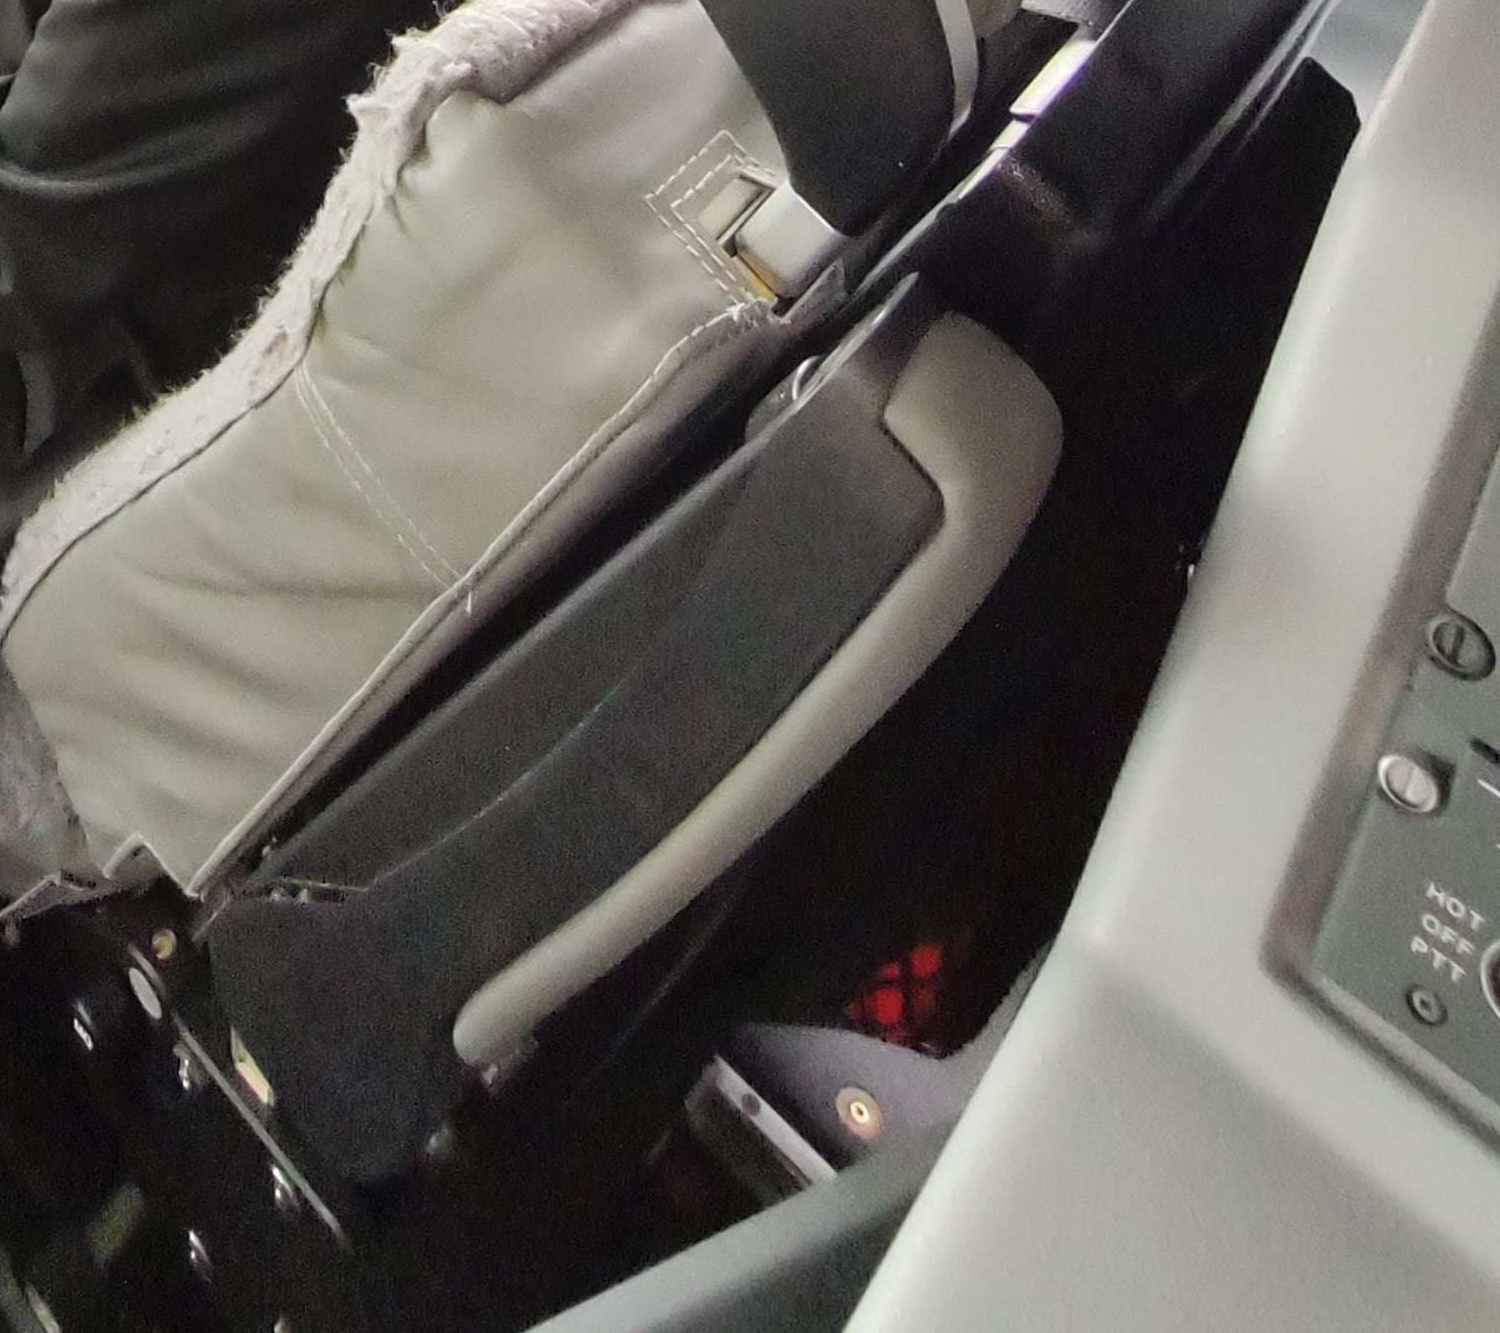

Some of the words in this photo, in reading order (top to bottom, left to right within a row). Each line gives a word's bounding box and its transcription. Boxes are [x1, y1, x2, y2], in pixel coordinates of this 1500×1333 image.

[1426, 882, 1487, 932] HOT
[1421, 913, 1477, 956] OFF
[1410, 936, 1467, 984] PTT
